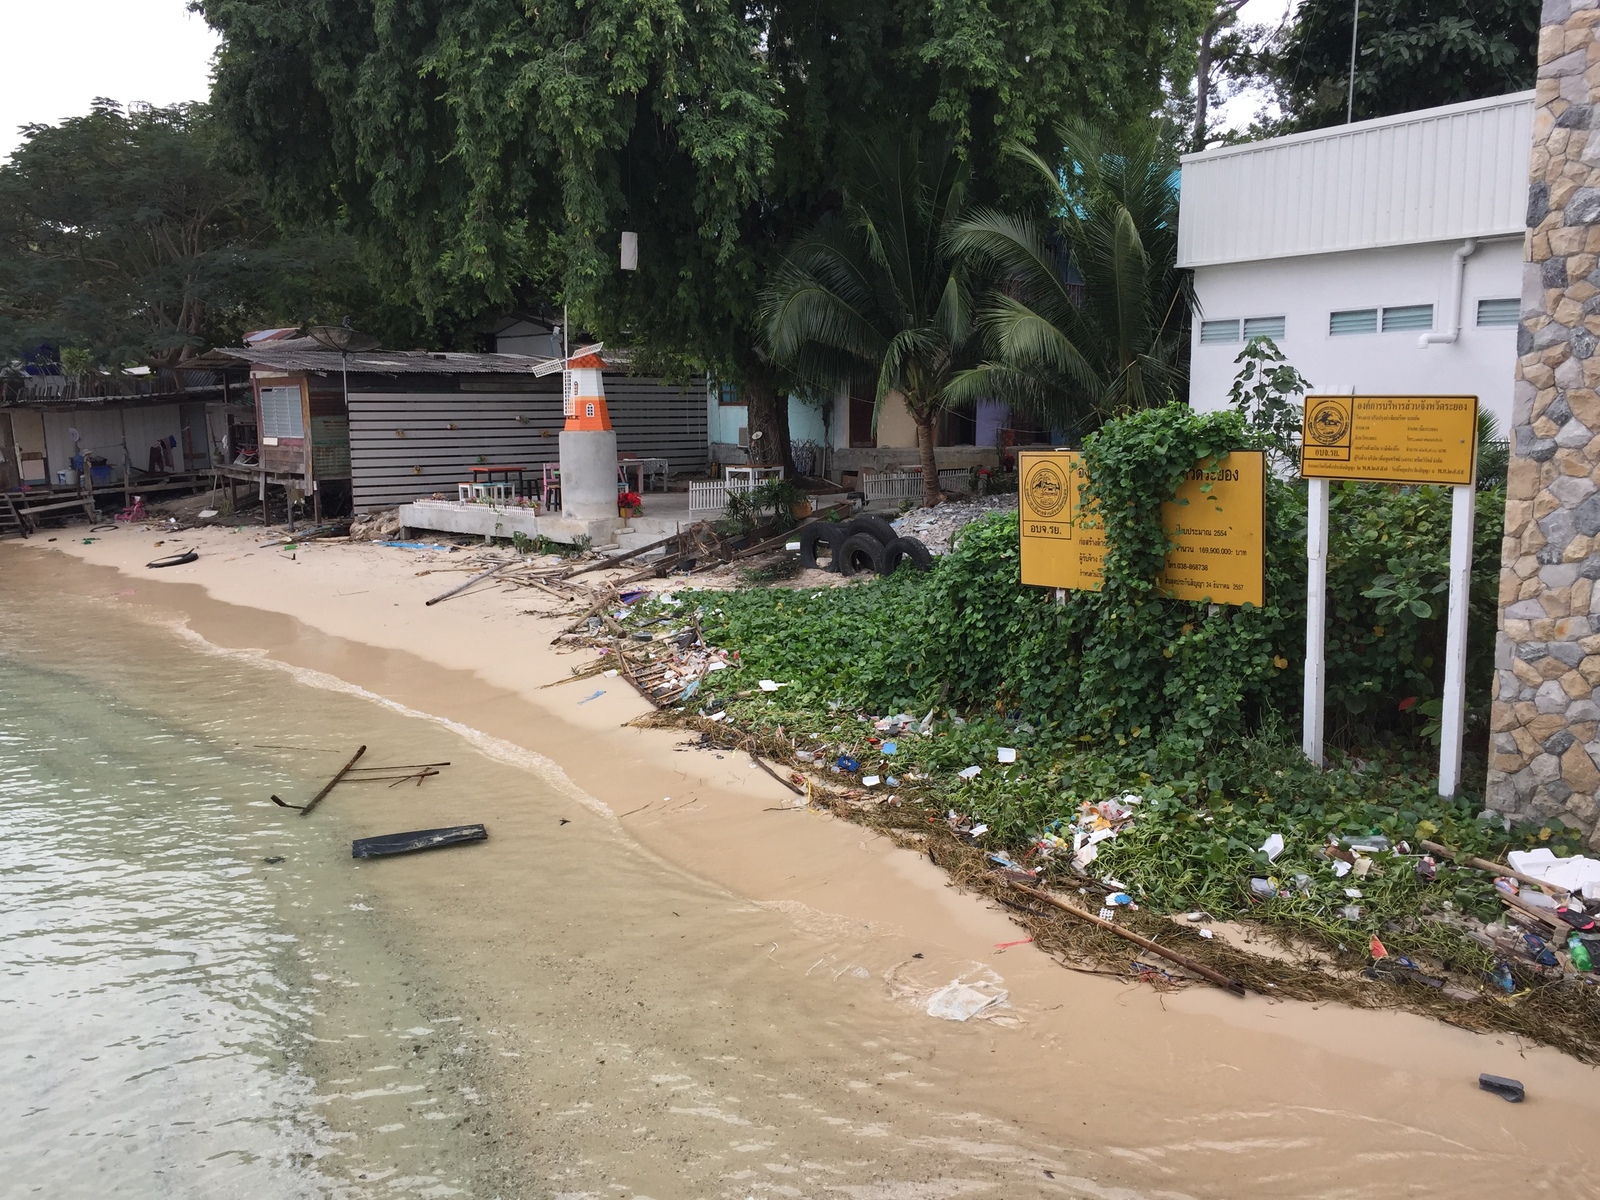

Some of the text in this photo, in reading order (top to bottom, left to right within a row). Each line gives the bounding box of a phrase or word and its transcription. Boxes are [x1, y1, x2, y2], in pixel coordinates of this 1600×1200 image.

[1357, 399, 1468, 411] องค์การบริหารส่วนจังหวัดระยอง
[1030, 524, 1062, 535] อบจ.รย.
[1213, 529, 1227, 537] 2554
